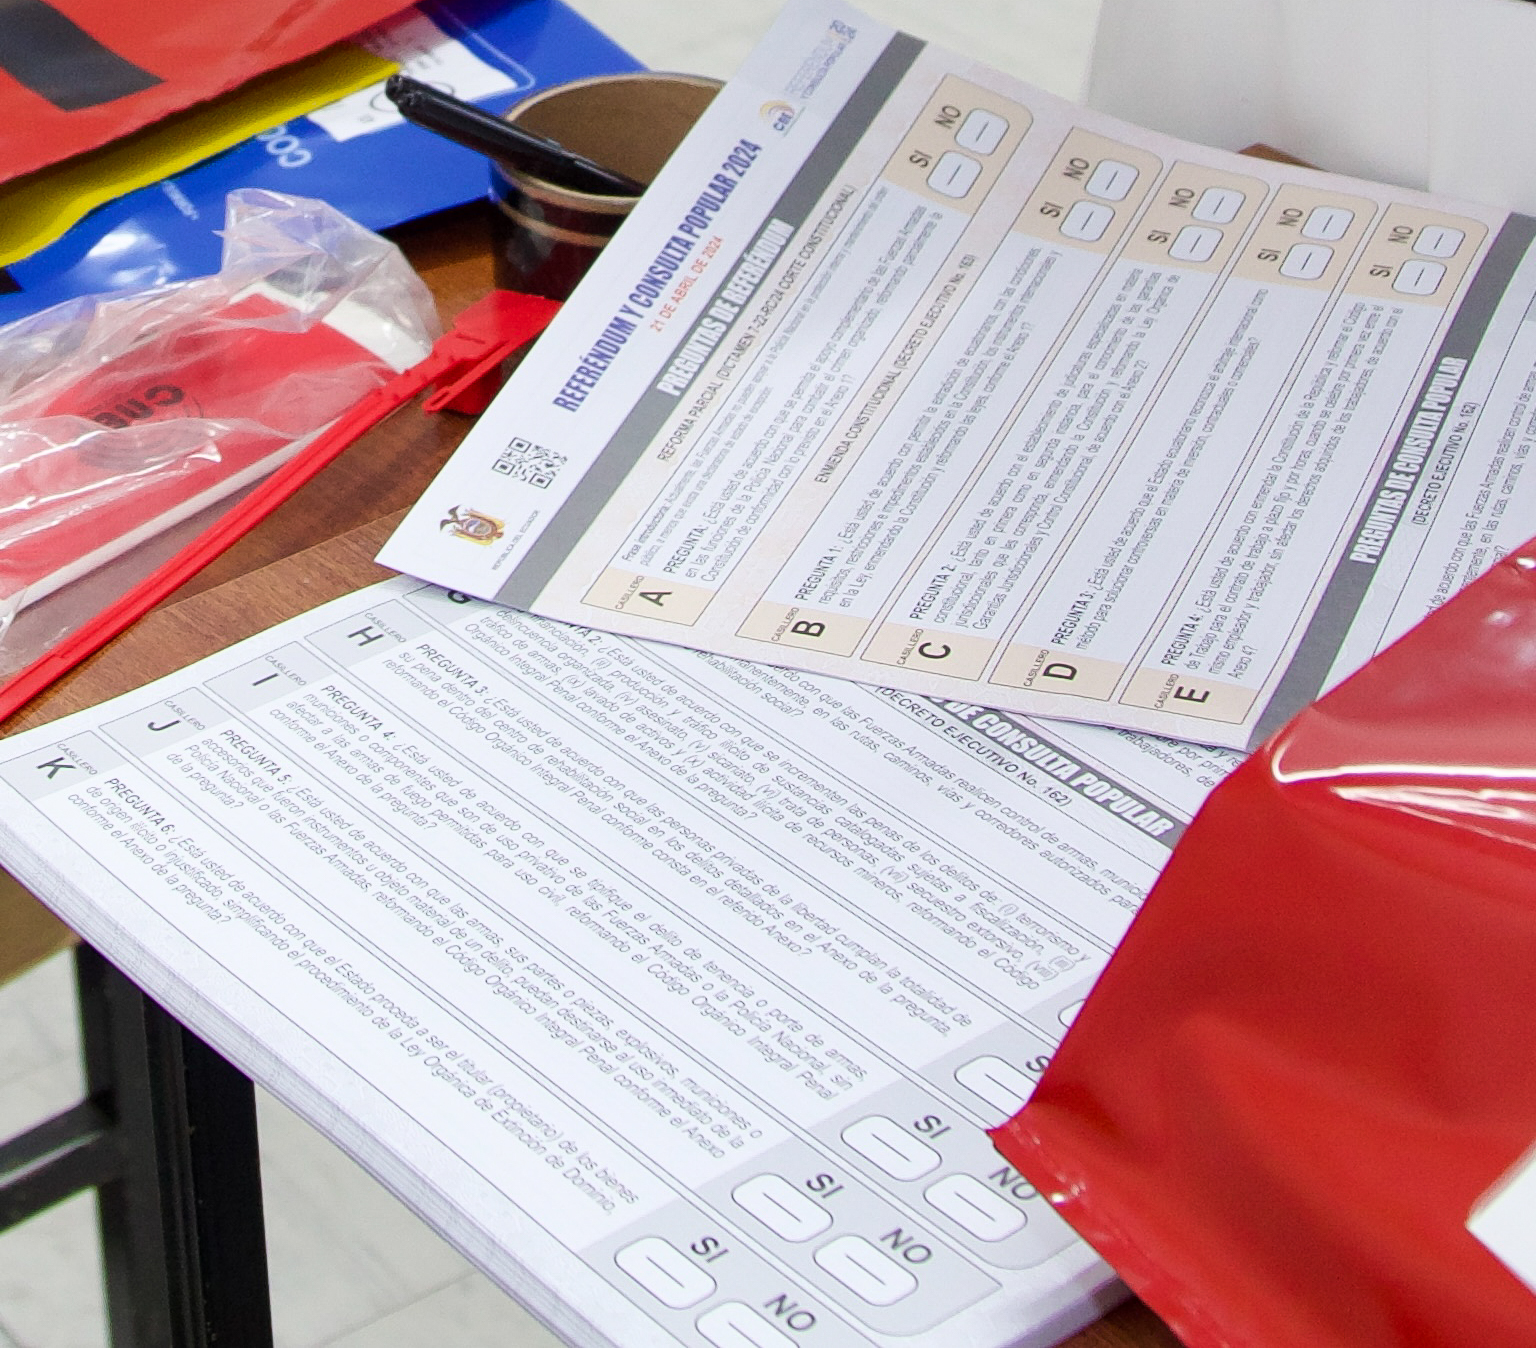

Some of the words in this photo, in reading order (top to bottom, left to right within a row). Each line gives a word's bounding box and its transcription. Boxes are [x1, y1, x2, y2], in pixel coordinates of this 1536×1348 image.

[721, 138, 762, 177] 2024
[908, 149, 933, 169] SI
[934, 105, 962, 130] NO
[677, 174, 738, 239] POPULAR
[1039, 201, 1064, 218] SI
[1062, 157, 1090, 181] NO
[1146, 229, 1171, 244] SI
[1168, 188, 1196, 209] NO
[1257, 248, 1281, 262] SI
[1276, 208, 1304, 227] NO
[628, 235, 696, 309] CONSULTA
[718, 218, 795, 305] REFERÉNDUM
[1369, 264, 1394, 278] SI
[1387, 225, 1414, 244] NO
[614, 303, 644, 319] Y
[649, 318, 665, 333] 21
[658, 303, 677, 320] DE
[670, 275, 699, 304] ABRIL
[690, 257, 709, 274] DE
[708, 298, 742, 323] DE
[552, 318, 637, 413] REFERÉNDUM
[656, 317, 727, 397] PREGUNTAS
[1420, 356, 1474, 412] POPULAR
[656, 418, 697, 462] REFORMA
[687, 381, 724, 418] PARCIAL
[1392, 410, 1450, 473] CONSULTA
[1384, 471, 1416, 491] DE
[1411, 481, 1451, 526] (DECRETO
[1431, 434, 1463, 482] EJECUTIVO
[1451, 420, 1470, 434] No.
[1349, 489, 1414, 564] PREGUNTAS
[662, 524, 709, 574] PREGUNTA:
[614, 575, 645, 610] CASILLERO
[638, 591, 673, 607] A
[794, 555, 837, 601] PREGUNTA
[909, 574, 951, 620] PREGUNTA
[347, 625, 385, 647] H
[364, 612, 407, 643] CASILLERO
[770, 606, 800, 642] CASILLERO
[790, 620, 826, 638] B
[1050, 600, 1090, 646] PREGUNTA
[1160, 623, 1199, 666] PREGUNTA
[896, 628, 925, 666] CASILLERO
[918, 642, 952, 660] C
[1023, 649, 1050, 687] CASILLERO
[252, 672, 279, 687] I
[264, 655, 307, 686] CASILLERO
[415, 643, 479, 689] PREGUNTA
[474, 685, 489, 697] 3:
[1042, 662, 1078, 681] D
[1153, 673, 1180, 709] CASILLERO
[164, 700, 206, 731] CASILLERO
[321, 684, 384, 731] PREGUNTA
[382, 731, 396, 741] 4:
[1173, 686, 1210, 704] E
[147, 719, 181, 732] J
[874, 686, 946, 728] (DECRETO
[942, 725, 1019, 773] EJECUTIVO
[1016, 771, 1038, 789] No.
[1042, 786, 1073, 807] 162)
[36, 756, 76, 780] K
[56, 743, 98, 776] CASILLERO
[219, 729, 282, 777] PREGUNTA
[276, 774, 292, 785] 5:
[966, 713, 1082, 781] CONSULTA
[1068, 772, 1174, 837] POPULAR
[104, 777, 166, 827] PREGUNTA
[160, 824, 176, 835] 6:
[167, 837, 207, 859] ¿Está
[199, 857, 236, 881] usted
[227, 879, 246, 893] de
[241, 891, 287, 925] acuerdo
[282, 923, 307, 941] con
[302, 939, 327, 957] que
[913, 1114, 951, 1139] SI
[988, 1166, 1042, 1201] NO
[805, 1173, 844, 1199] SI
[879, 1227, 933, 1264] NO
[690, 1236, 729, 1263] SI
[764, 1293, 817, 1332] NO
